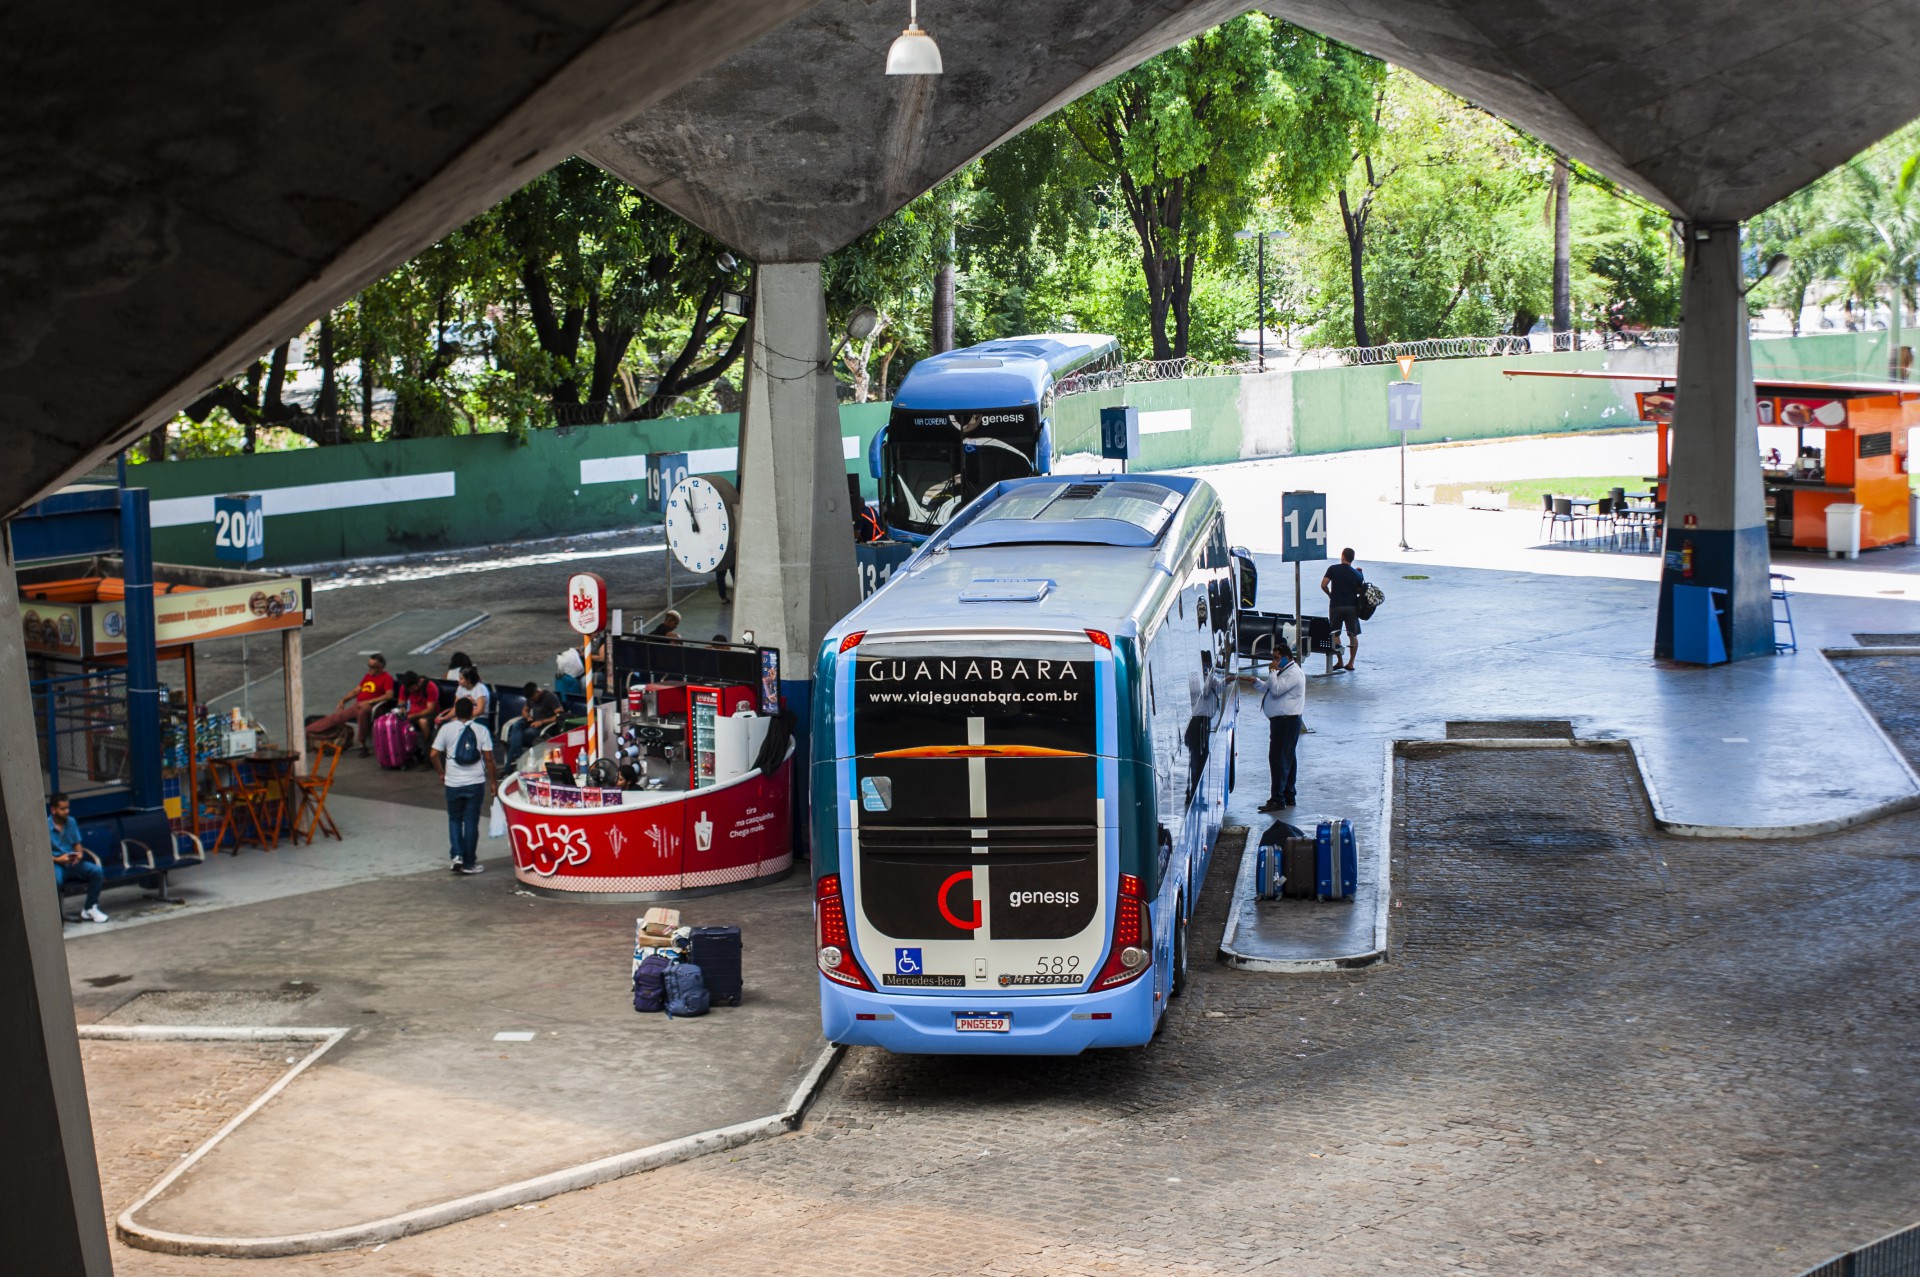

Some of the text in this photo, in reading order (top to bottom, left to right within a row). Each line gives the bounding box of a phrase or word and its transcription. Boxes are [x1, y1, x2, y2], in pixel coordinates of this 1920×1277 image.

[1390, 394, 1421, 420] 17
[981, 413, 1025, 426] genesis
[1101, 420, 1126, 449] 18
[646, 467, 660, 501] 19
[679, 485, 686, 493] 11
[692, 480, 699, 488] 12
[707, 486, 712, 494] 1
[670, 500, 677, 508] 10
[718, 502, 722, 510] 2
[246, 508, 264, 548] 20
[668, 519, 673, 527] 9
[722, 523, 727, 531] 3
[1284, 508, 1327, 548] 14
[215, 509, 246, 549] 20
[673, 540, 678, 548] 8
[719, 543, 724, 551] 4
[683, 555, 688, 563] 7
[710, 557, 715, 565] 5
[696, 562, 701, 570] 6
[573, 594, 593, 612] Bob's
[869, 660, 1078, 681] GUANABARA
[729, 828, 750, 838] Chega
[510, 823, 592, 877] Bob's
[1009, 890, 1080, 908] genesis
[1036, 955, 1080, 974] 589
[886, 975, 962, 986] Mercedes-Benz
[1013, 974, 1083, 984] Marcopolo
[961, 1019, 1004, 1029] PNG5E59
